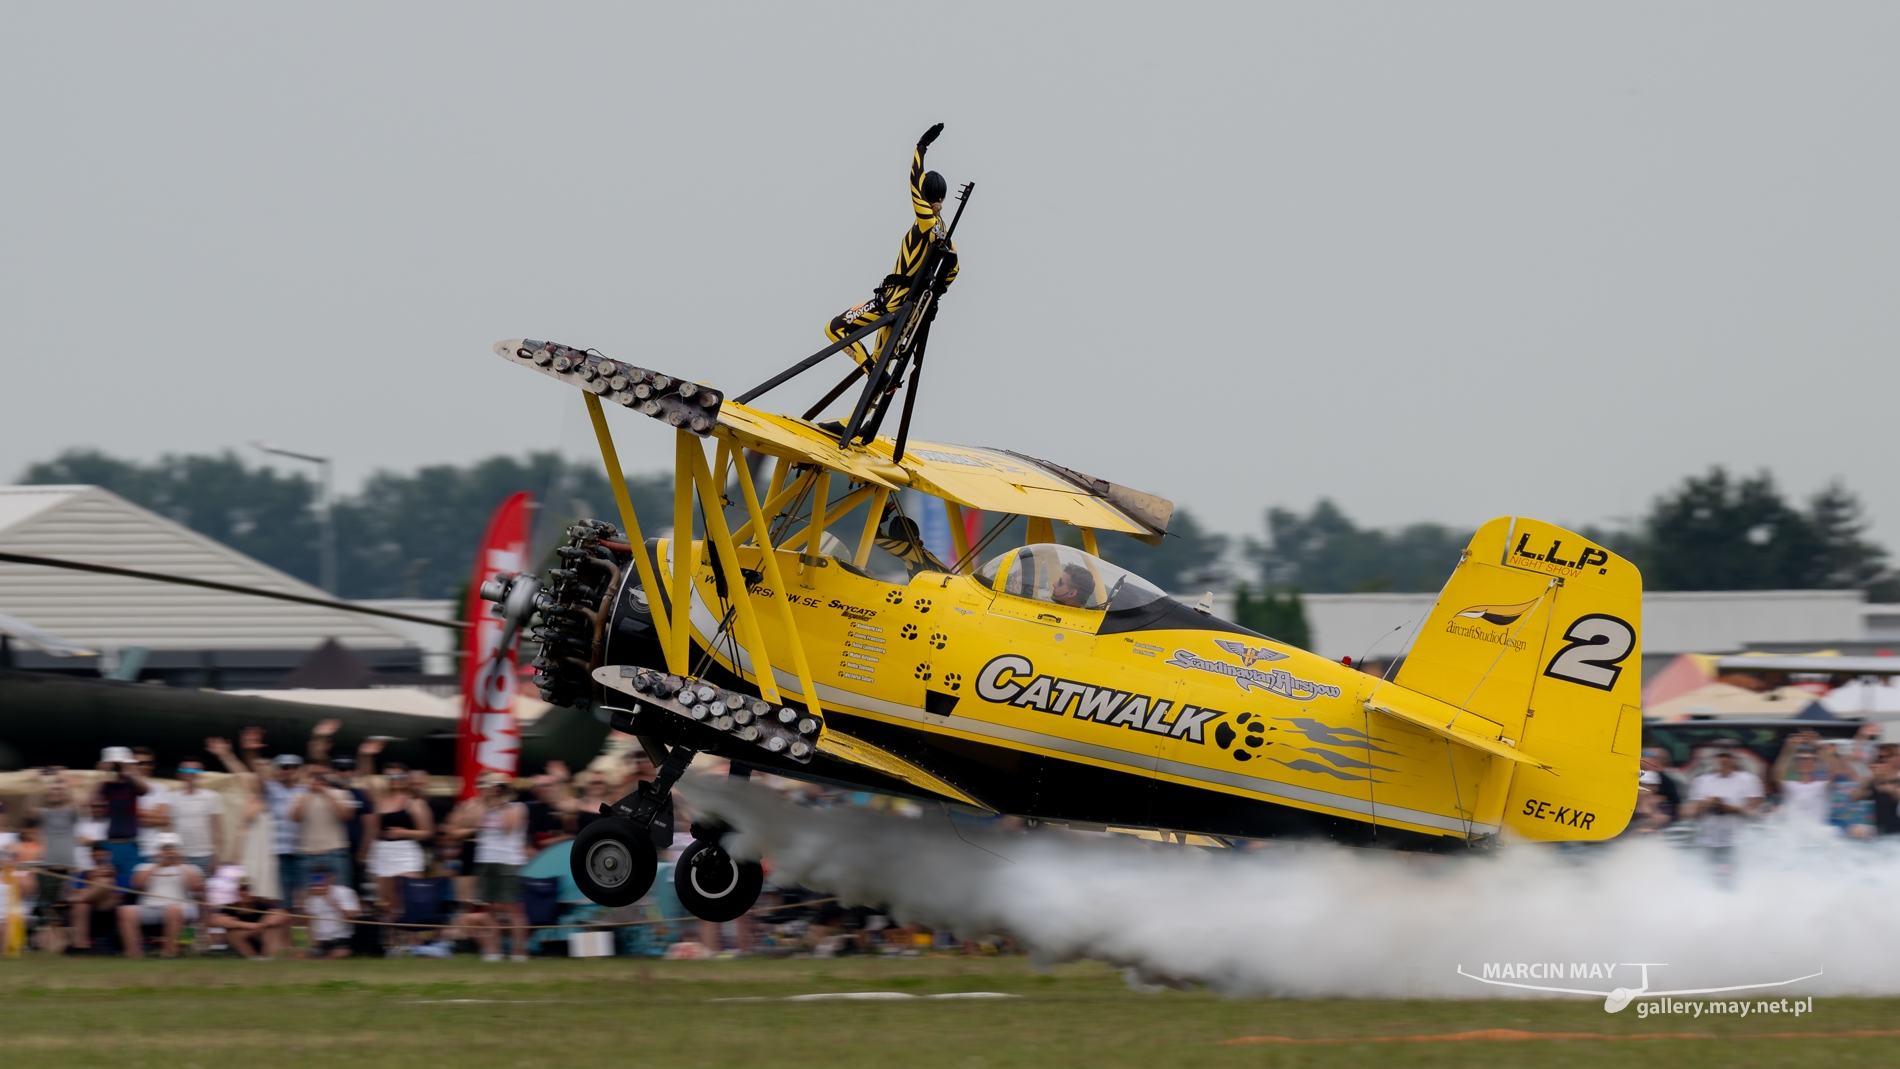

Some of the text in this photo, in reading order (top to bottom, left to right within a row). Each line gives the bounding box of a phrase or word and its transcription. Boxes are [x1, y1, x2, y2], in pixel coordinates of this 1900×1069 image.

[845, 301, 876, 325] SKYCA
[1509, 556, 1581, 578] NIGHT SHOW
[1514, 533, 1607, 575] L.L.P.
[828, 600, 877, 617] SKYCATS
[1543, 613, 1637, 692] 2
[1165, 650, 1341, 701] Scandinavian Airshow
[1523, 799, 1596, 830] SE-KXR
